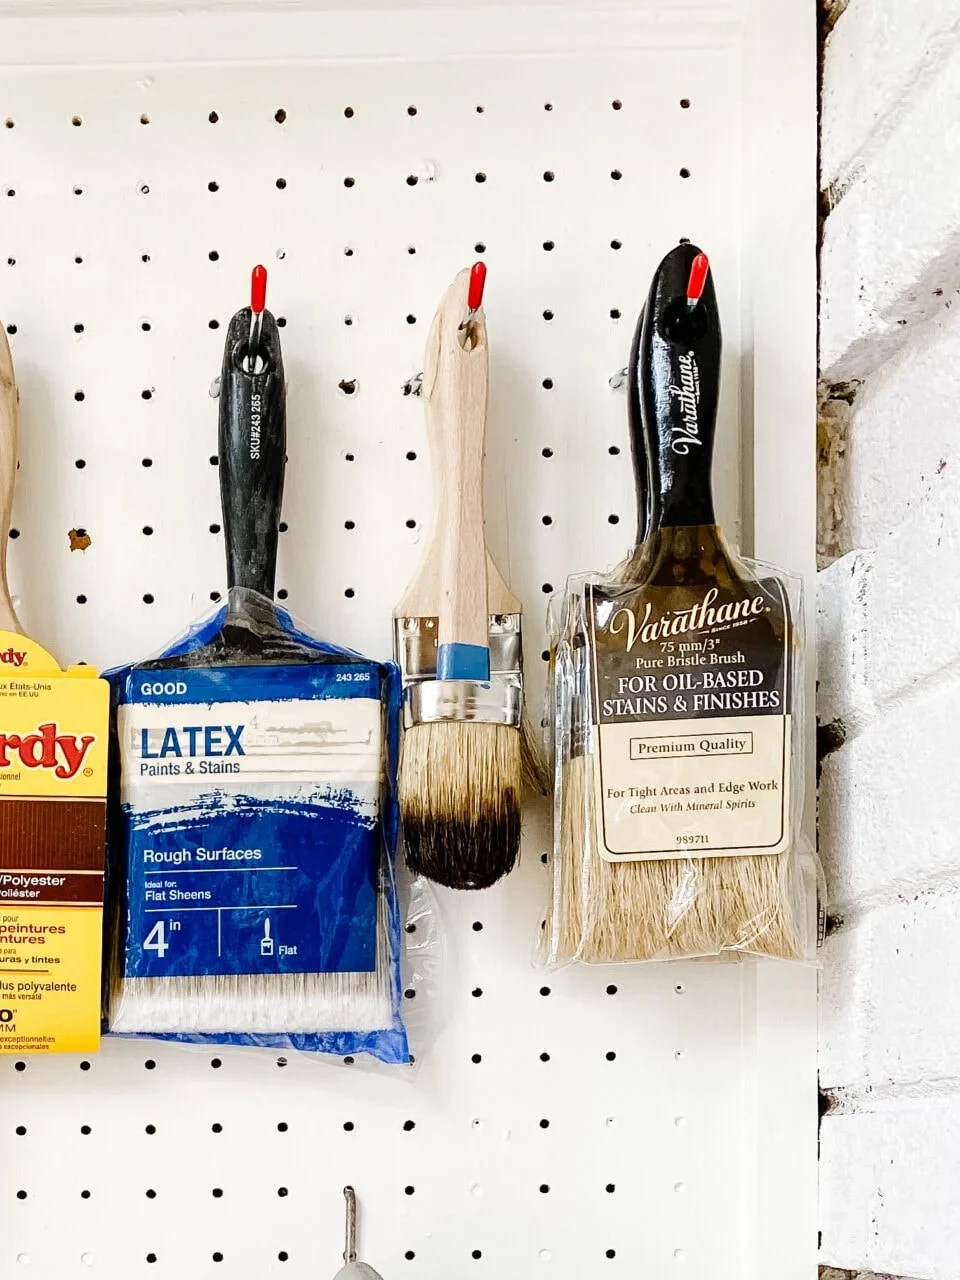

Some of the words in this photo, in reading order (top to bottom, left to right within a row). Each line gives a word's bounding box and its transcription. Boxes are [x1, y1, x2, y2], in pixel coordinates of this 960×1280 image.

[251, 394, 261, 412] 265
[669, 355, 703, 455] Varathane
[250, 414, 261, 460] SKU#243
[610, 587, 766, 653] Varathane
[660, 642, 675, 653] 75
[636, 657, 664, 670] Pure
[667, 654, 707, 668] Bristle
[710, 653, 746, 666] Brush
[336, 674, 352, 682] 243
[353, 673, 371, 681] 265
[618, 675, 657, 694] FOR
[662, 669, 765, 692] OIL-BASED
[10, 681, 52, 692] États-Unis
[140, 682, 188, 696] GOOD
[602, 696, 668, 717] STAINS
[673, 695, 688, 712] &
[692, 690, 781, 710] FINISHES
[140, 724, 246, 759] LATEX
[638, 740, 696, 754] Premium
[699, 738, 747, 754] Quality
[140, 762, 181, 777] Paints
[184, 762, 196, 775] &
[198, 760, 241, 774] Stains
[607, 788, 626, 799] For
[628, 786, 658, 802] Tight
[660, 785, 691, 797] Areas
[694, 784, 716, 796] and
[718, 782, 746, 798] Edge
[748, 780, 780, 792] Work
[630, 804, 658, 815] Clean
[660, 802, 684, 813] With
[686, 800, 724, 812] Mineral
[726, 798, 756, 813] Spirits
[676, 834, 710, 846] 989711
[143, 848, 192, 864] Rough
[196, 847, 262, 862] Surfaces
[144, 881, 162, 889] Ideal
[164, 880, 177, 888] for:
[145, 890, 167, 901] Flat
[168, 889, 212, 901] Sheens
[2, 914, 19, 924] pour
[142, 920, 170, 958] 4
[170, 918, 182, 931] in
[278, 945, 298, 956] Flat
[17, 981, 78, 994] polyvalente
[0, 1034, 56, 1044] exceptionnelles
